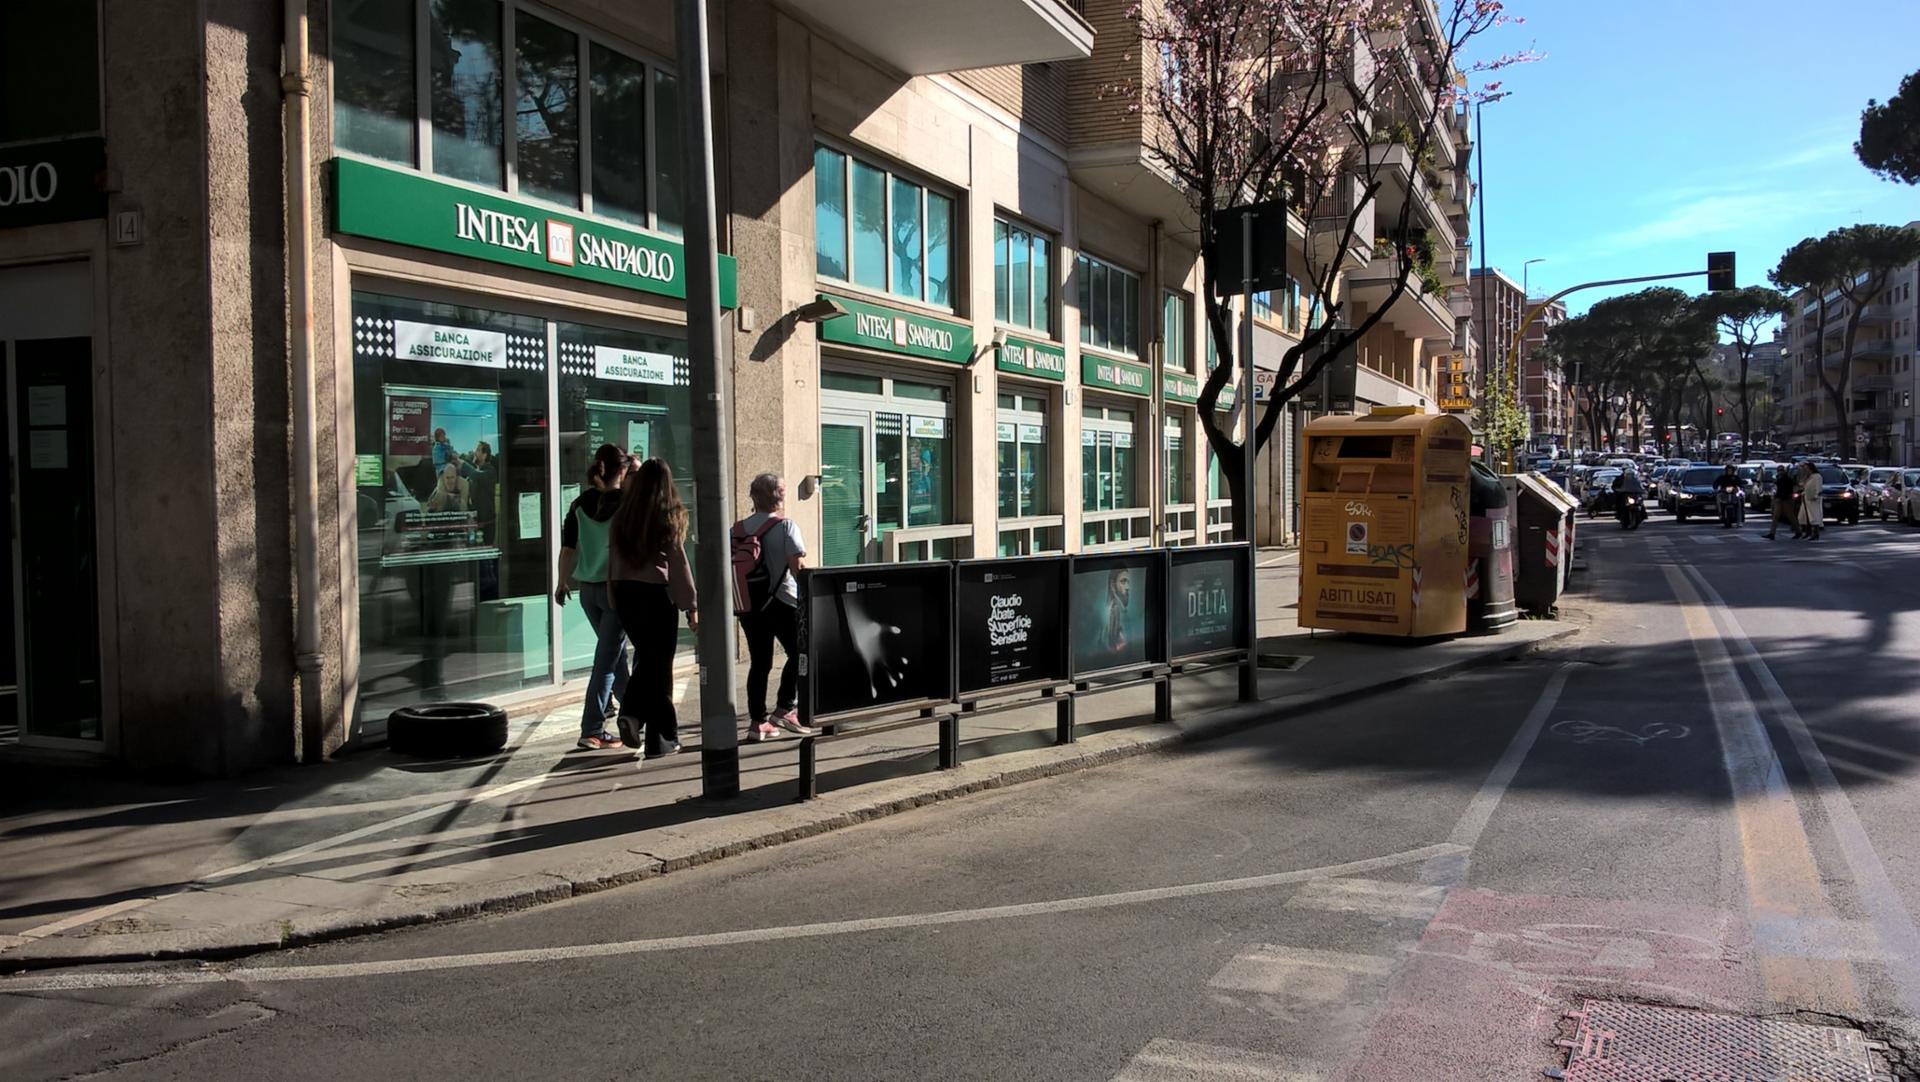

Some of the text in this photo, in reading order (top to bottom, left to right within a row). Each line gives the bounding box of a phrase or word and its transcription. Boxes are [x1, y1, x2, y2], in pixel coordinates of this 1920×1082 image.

[456, 203, 674, 283] INTESA SANPAOLO
[434, 331, 470, 346] BANCA
[856, 312, 953, 352] INTESA SANPAOLO
[409, 345, 493, 363] ASSICURAZIONE
[622, 354, 648, 367] BANCA
[605, 366, 665, 381] ASSICURAZIONE
[990, 594, 1022, 608] Claudio
[1187, 589, 1228, 617] DELTA
[1319, 588, 1396, 606] ABITI USATI
[990, 607, 1015, 621] Abate
[987, 615, 1032, 635] Superficie
[990, 630, 1028, 647] Sensibile
